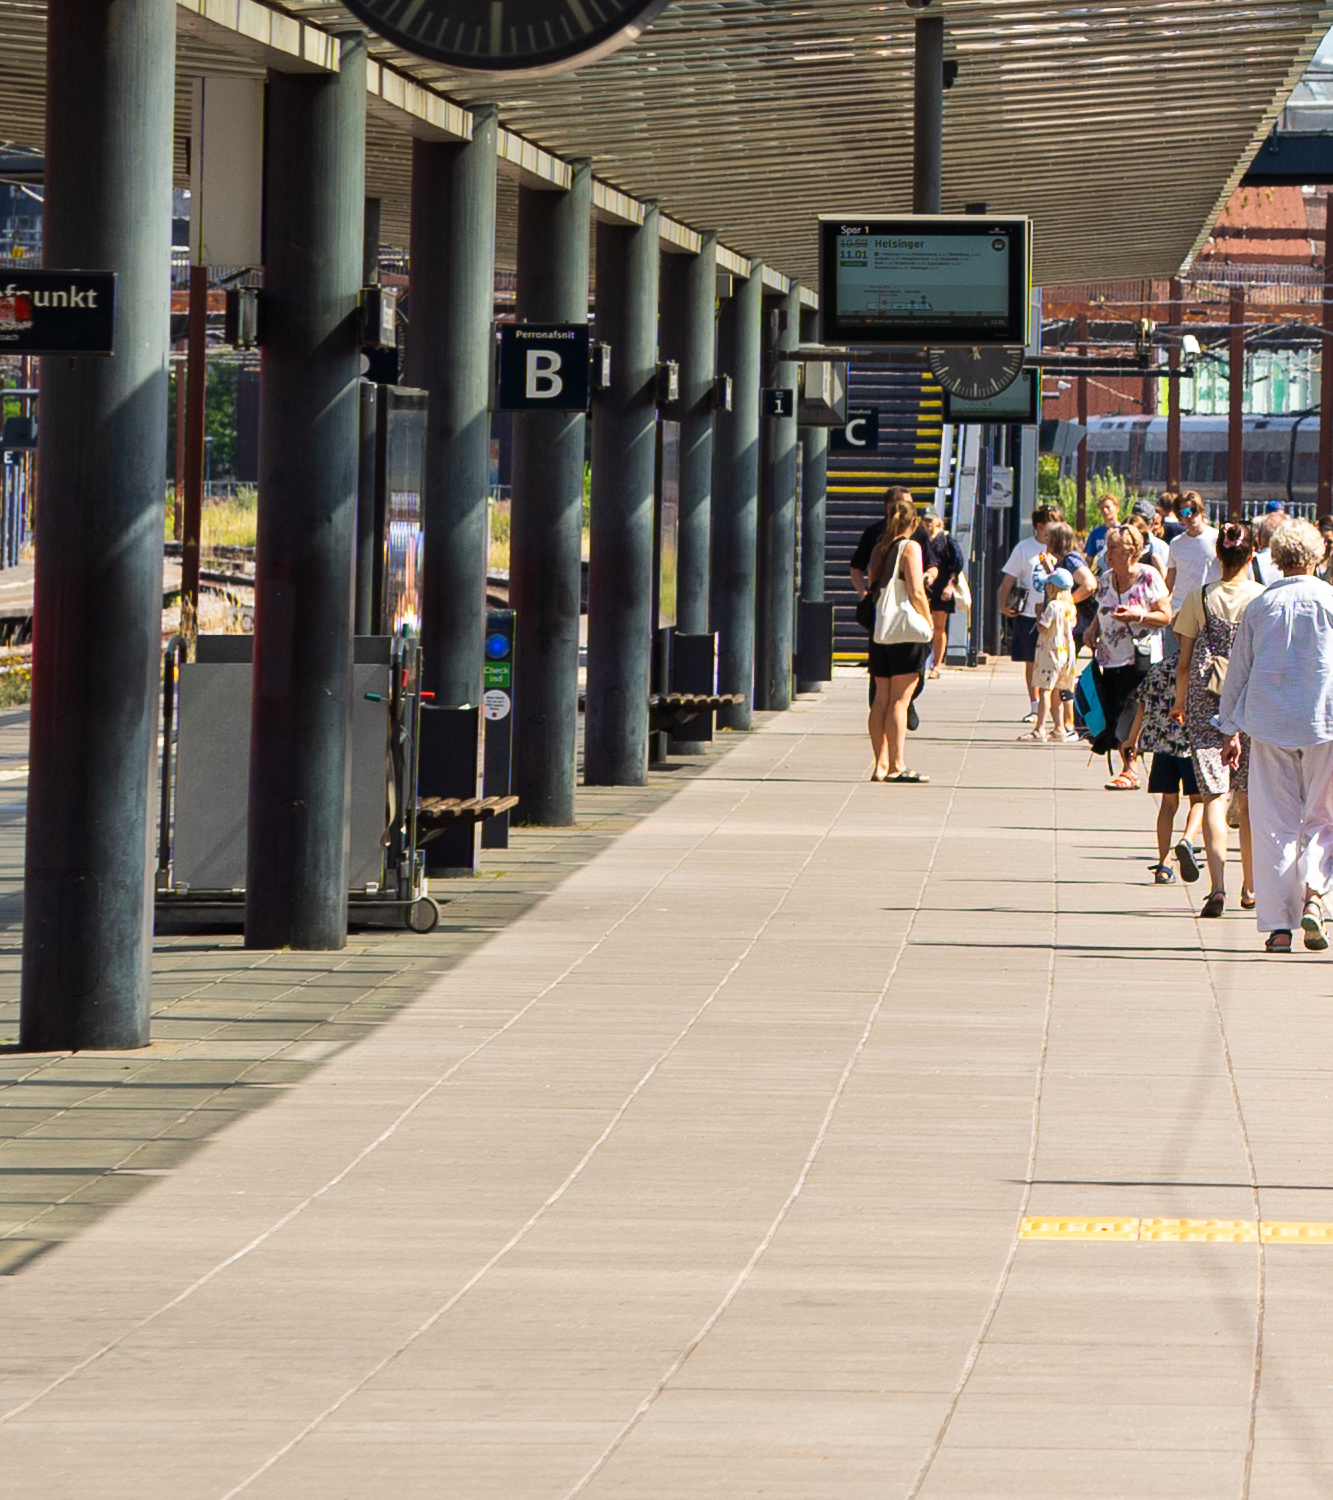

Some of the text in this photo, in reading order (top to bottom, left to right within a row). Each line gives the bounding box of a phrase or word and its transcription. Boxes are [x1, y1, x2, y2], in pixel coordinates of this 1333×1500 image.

[841, 225, 869, 236] Spor 1
[840, 250, 868, 259] 11.01
[526, 350, 562, 398] B
[774, 399, 784, 413] 1
[845, 419, 866, 446] C
